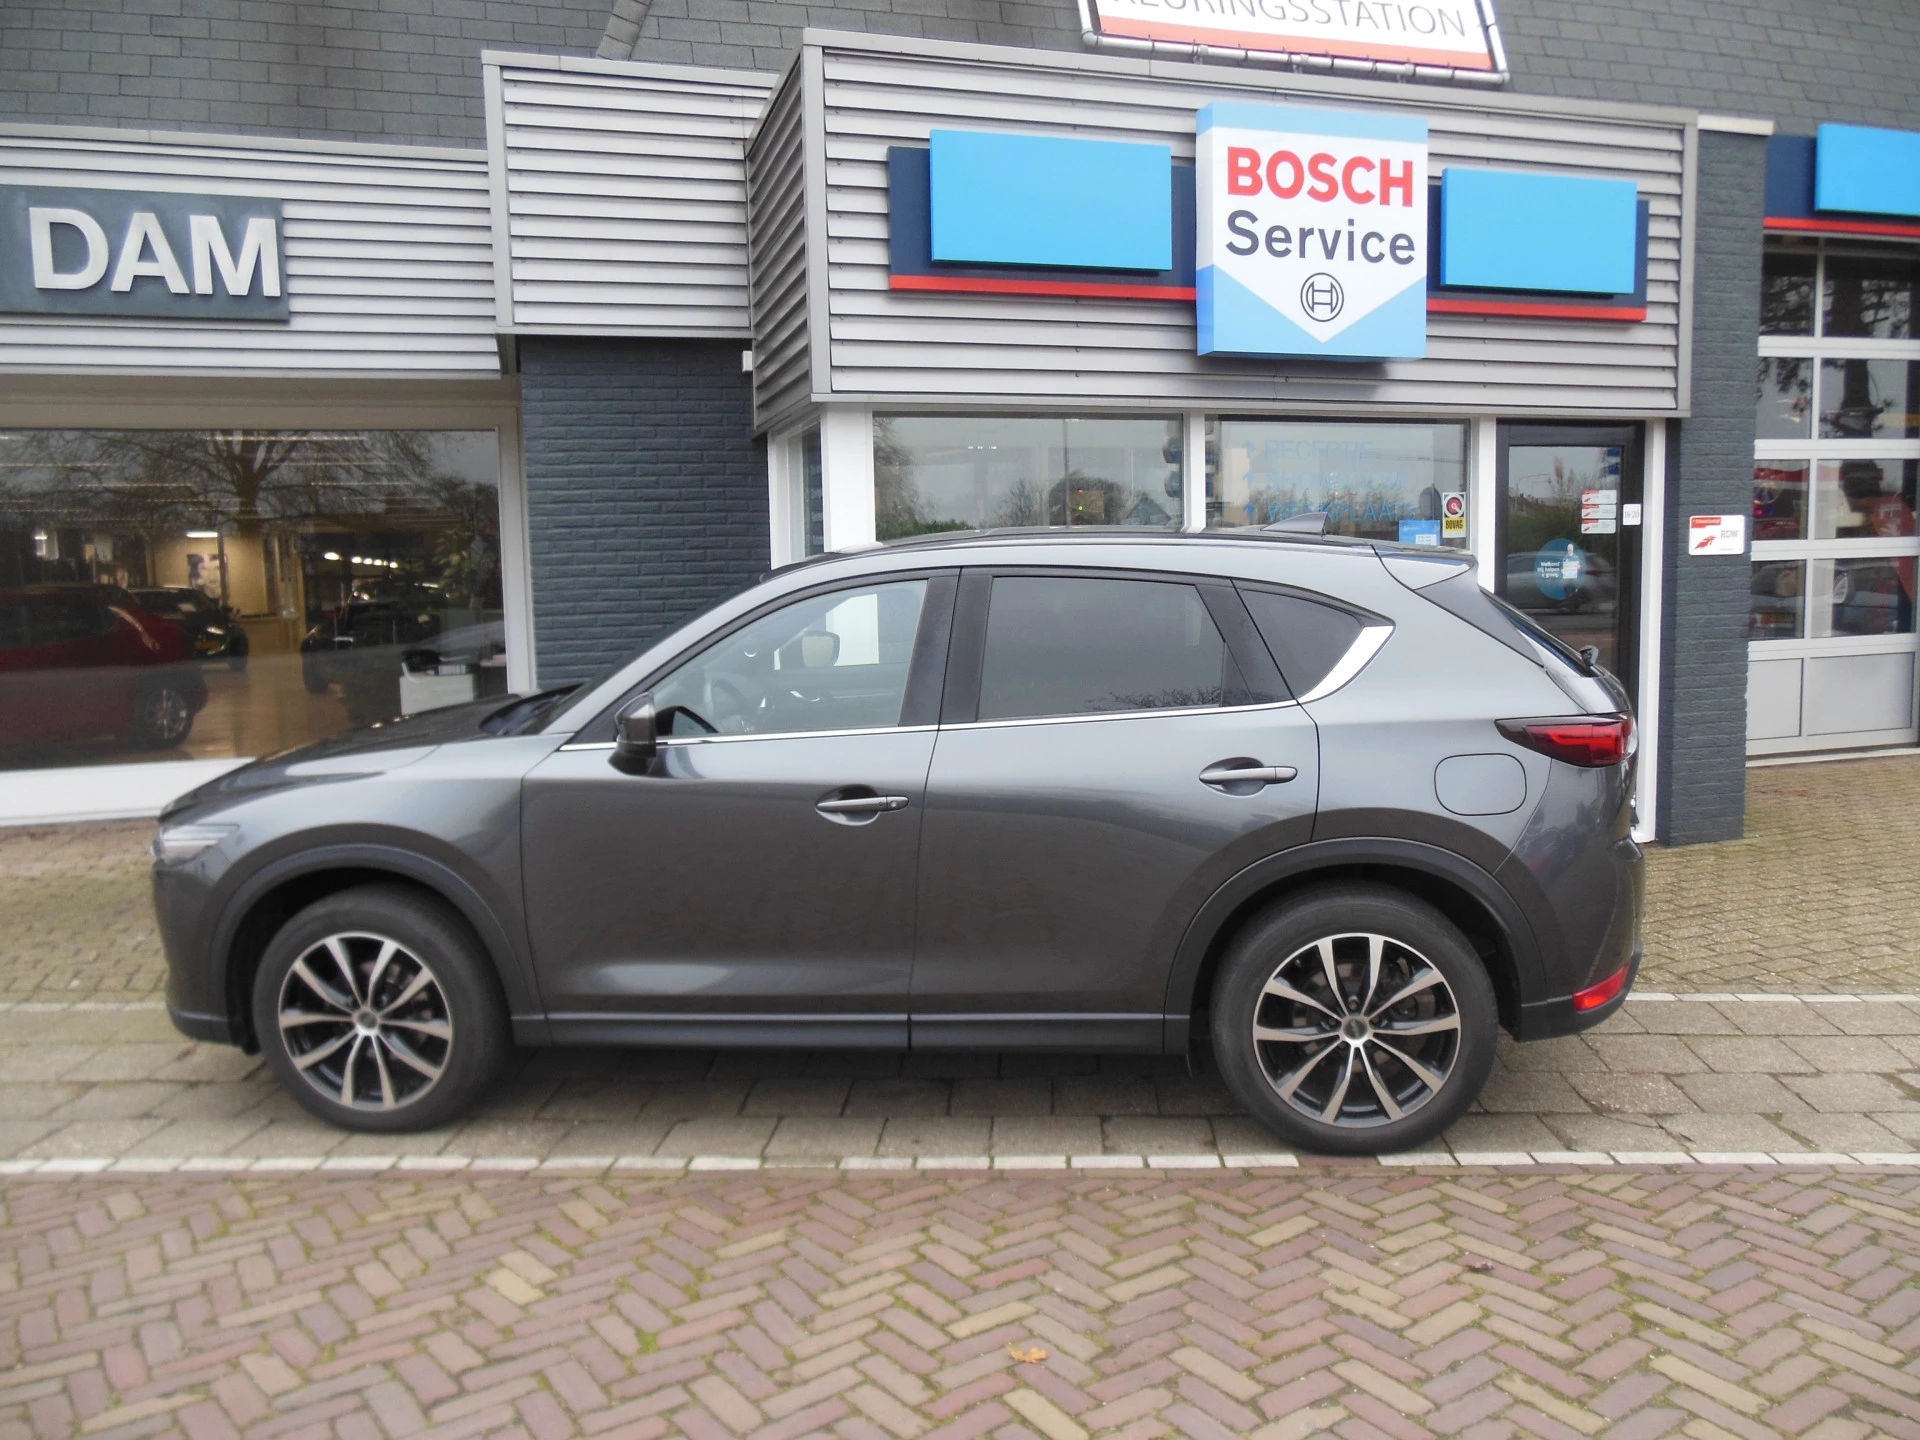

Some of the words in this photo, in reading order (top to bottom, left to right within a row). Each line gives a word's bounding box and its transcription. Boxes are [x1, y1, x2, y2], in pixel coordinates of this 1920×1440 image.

[1113, 0, 1466, 37] INGSSTATION
[1226, 145, 1414, 208] BOSCH
[28, 206, 282, 298] DAM
[1225, 209, 1416, 266] Service
[1264, 439, 1374, 460] RECEPTIE
[1266, 470, 1407, 492] SHOWROOM
[1445, 519, 1463, 530] BOVAG
[1721, 529, 1739, 539] RDW
